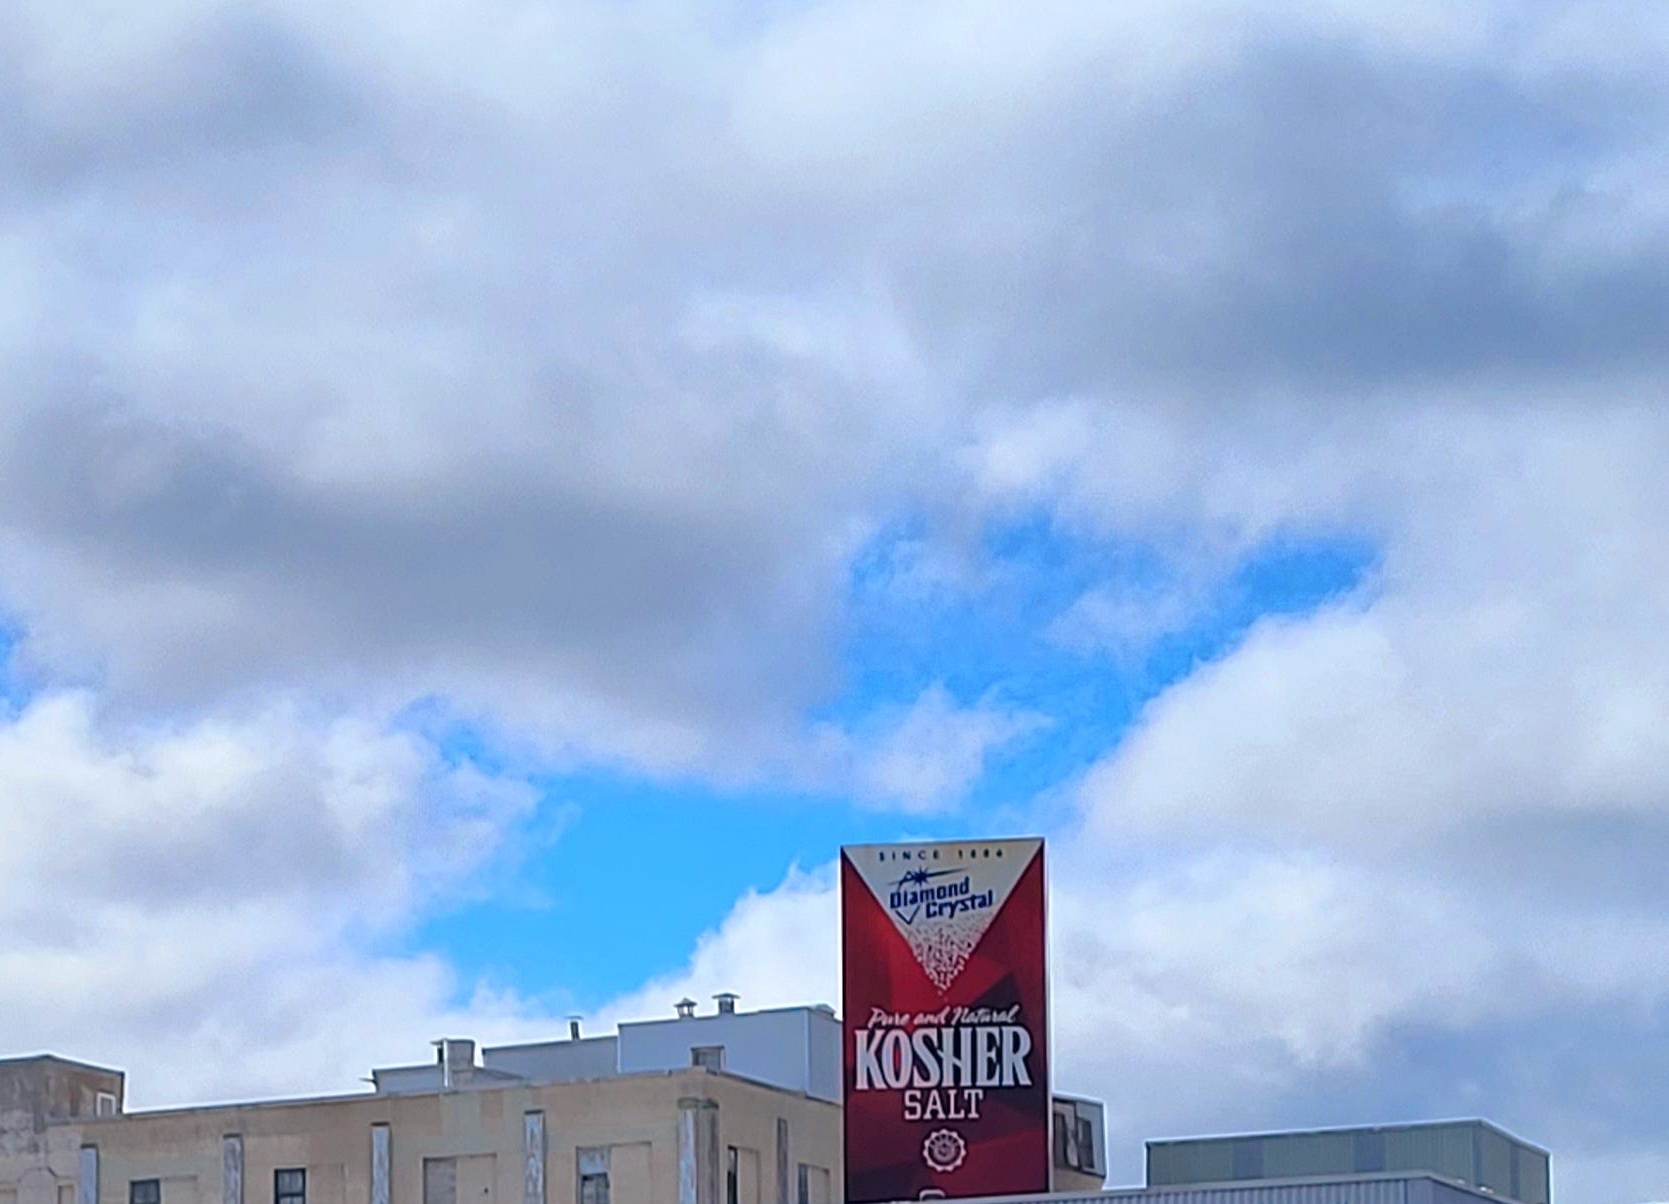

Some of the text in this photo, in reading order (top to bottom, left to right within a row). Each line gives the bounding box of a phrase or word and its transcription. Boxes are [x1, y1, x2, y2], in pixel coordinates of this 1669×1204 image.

[879, 850, 939, 862] SINCE
[890, 876, 970, 909] Diamond
[926, 890, 993, 919] Crystal
[867, 1005, 1020, 1029] Pure and Natural
[854, 1026, 1032, 1090] KOSHER
[904, 1089, 983, 1120] SALT
